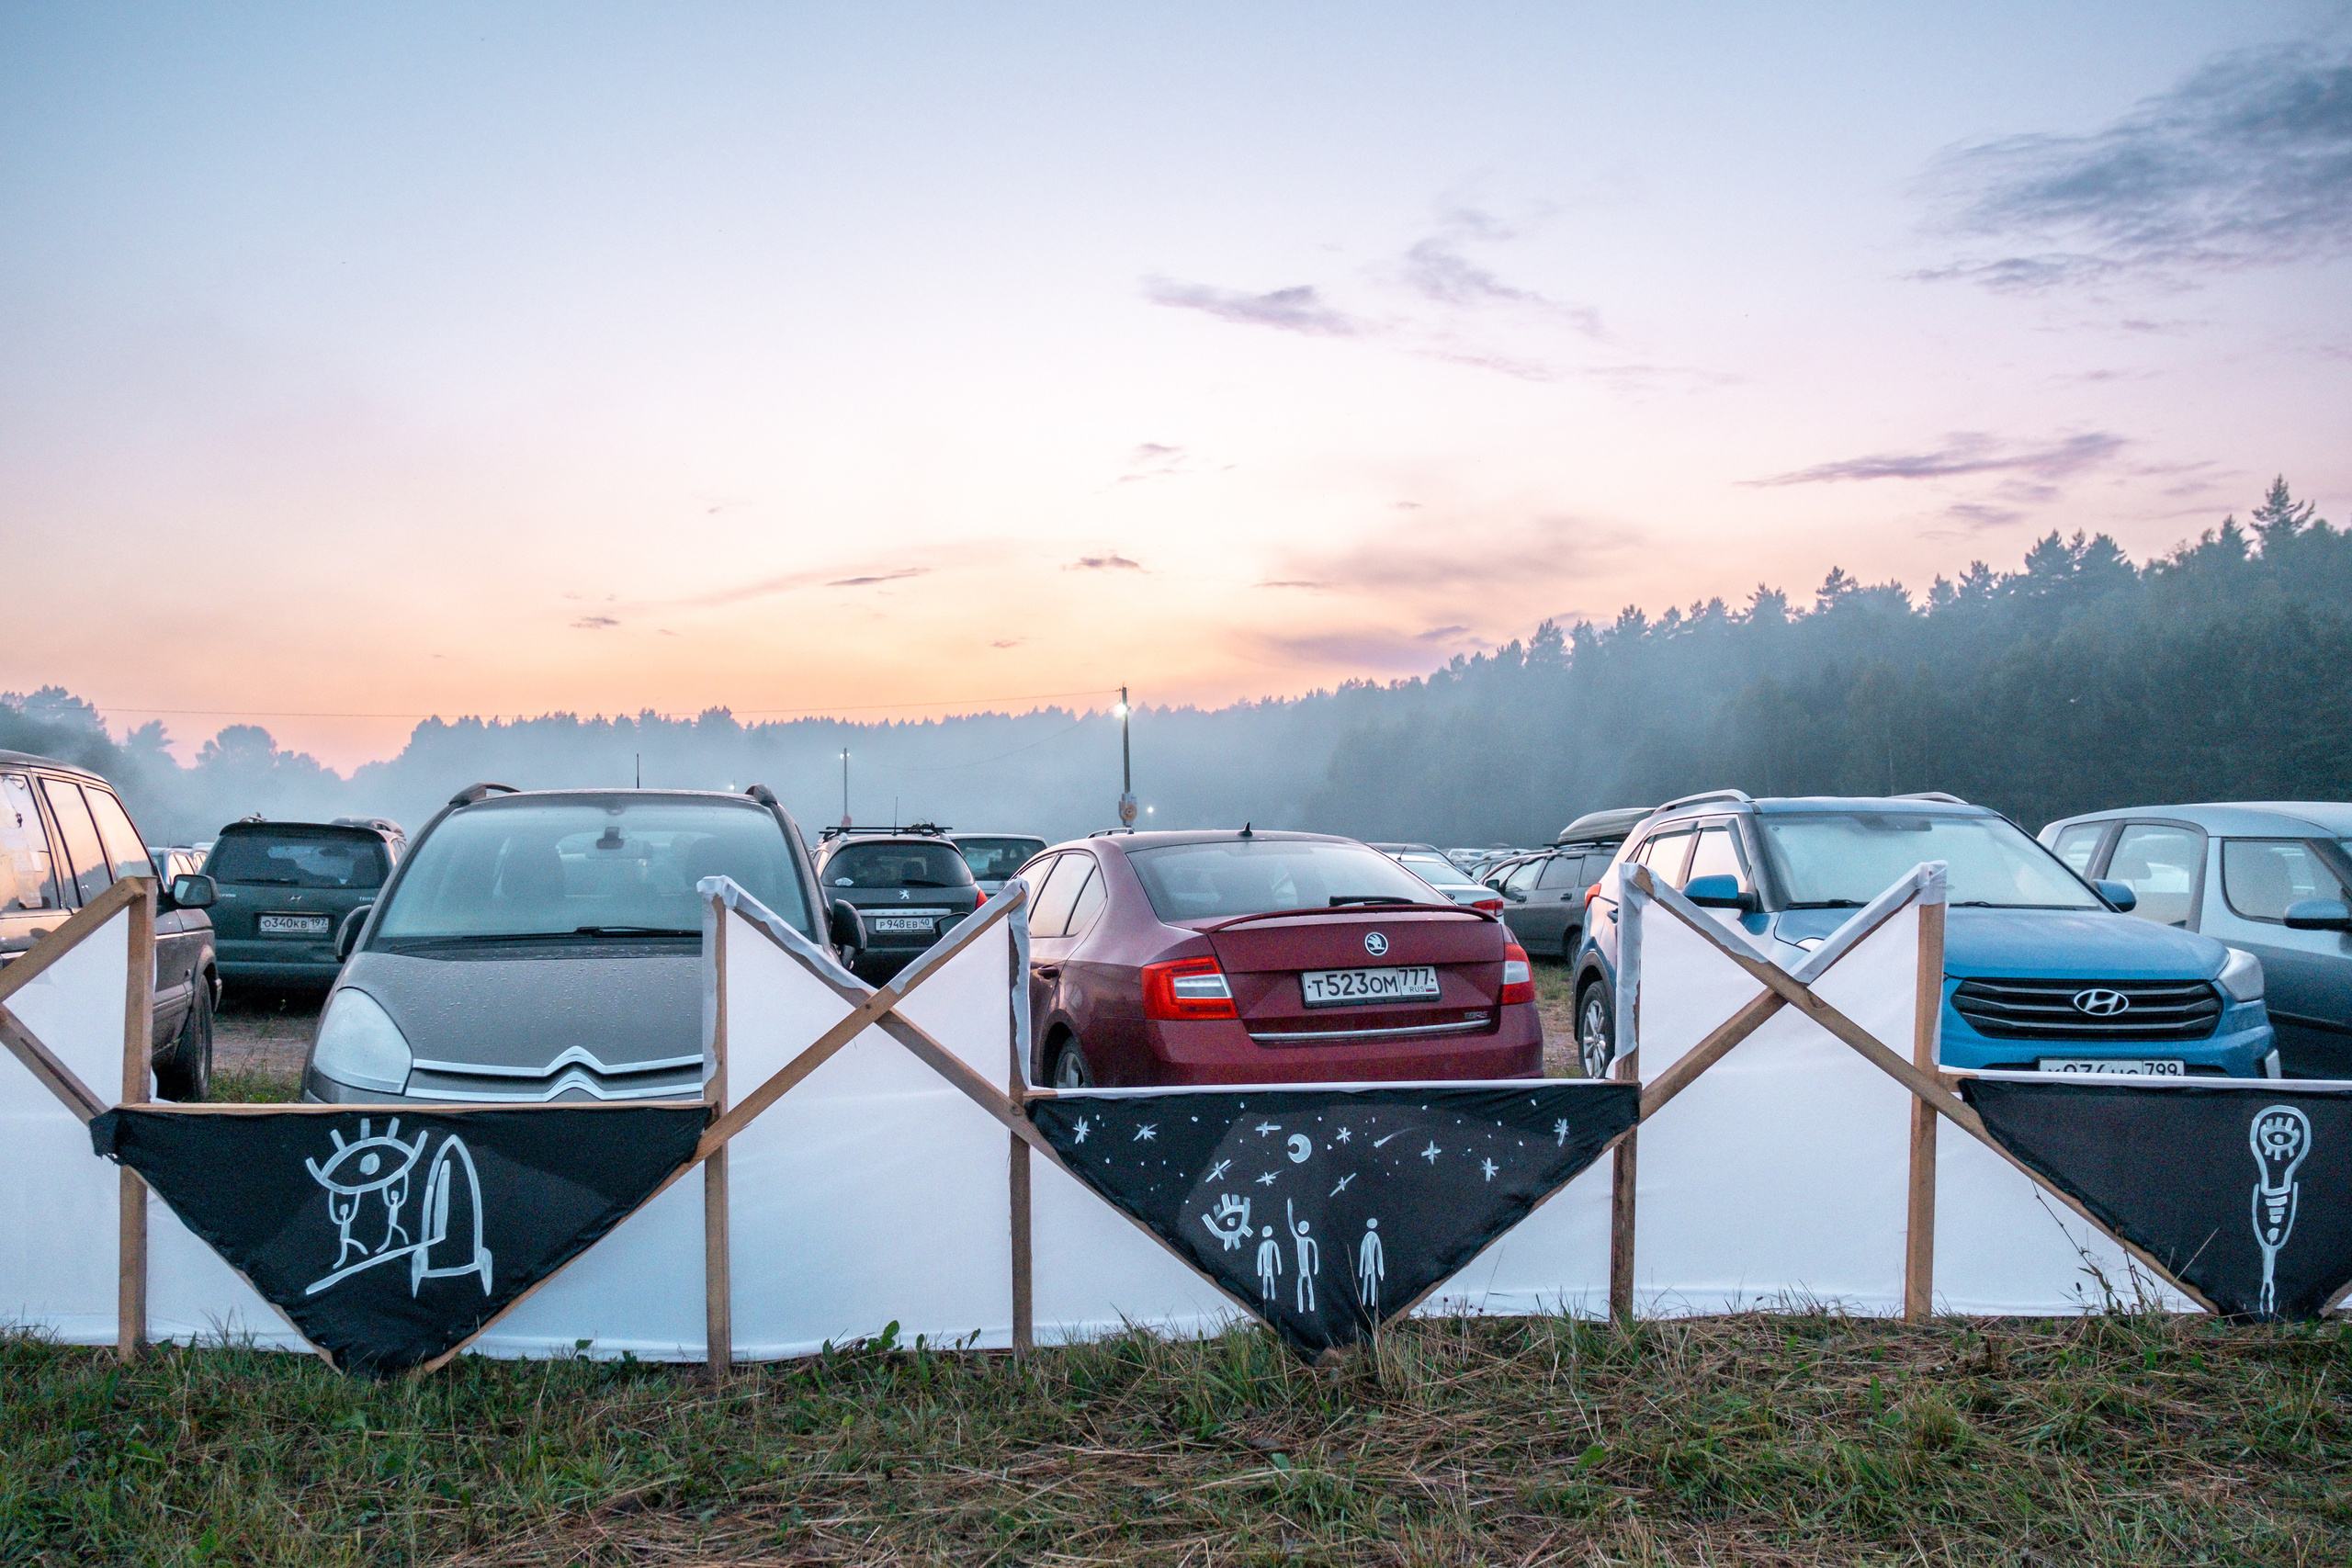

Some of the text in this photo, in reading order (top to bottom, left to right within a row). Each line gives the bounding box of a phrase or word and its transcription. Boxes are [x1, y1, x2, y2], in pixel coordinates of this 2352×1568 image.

[310, 918, 326, 927] 197
[1398, 968, 1429, 986] 777
[2144, 1063, 2178, 1077] 799
